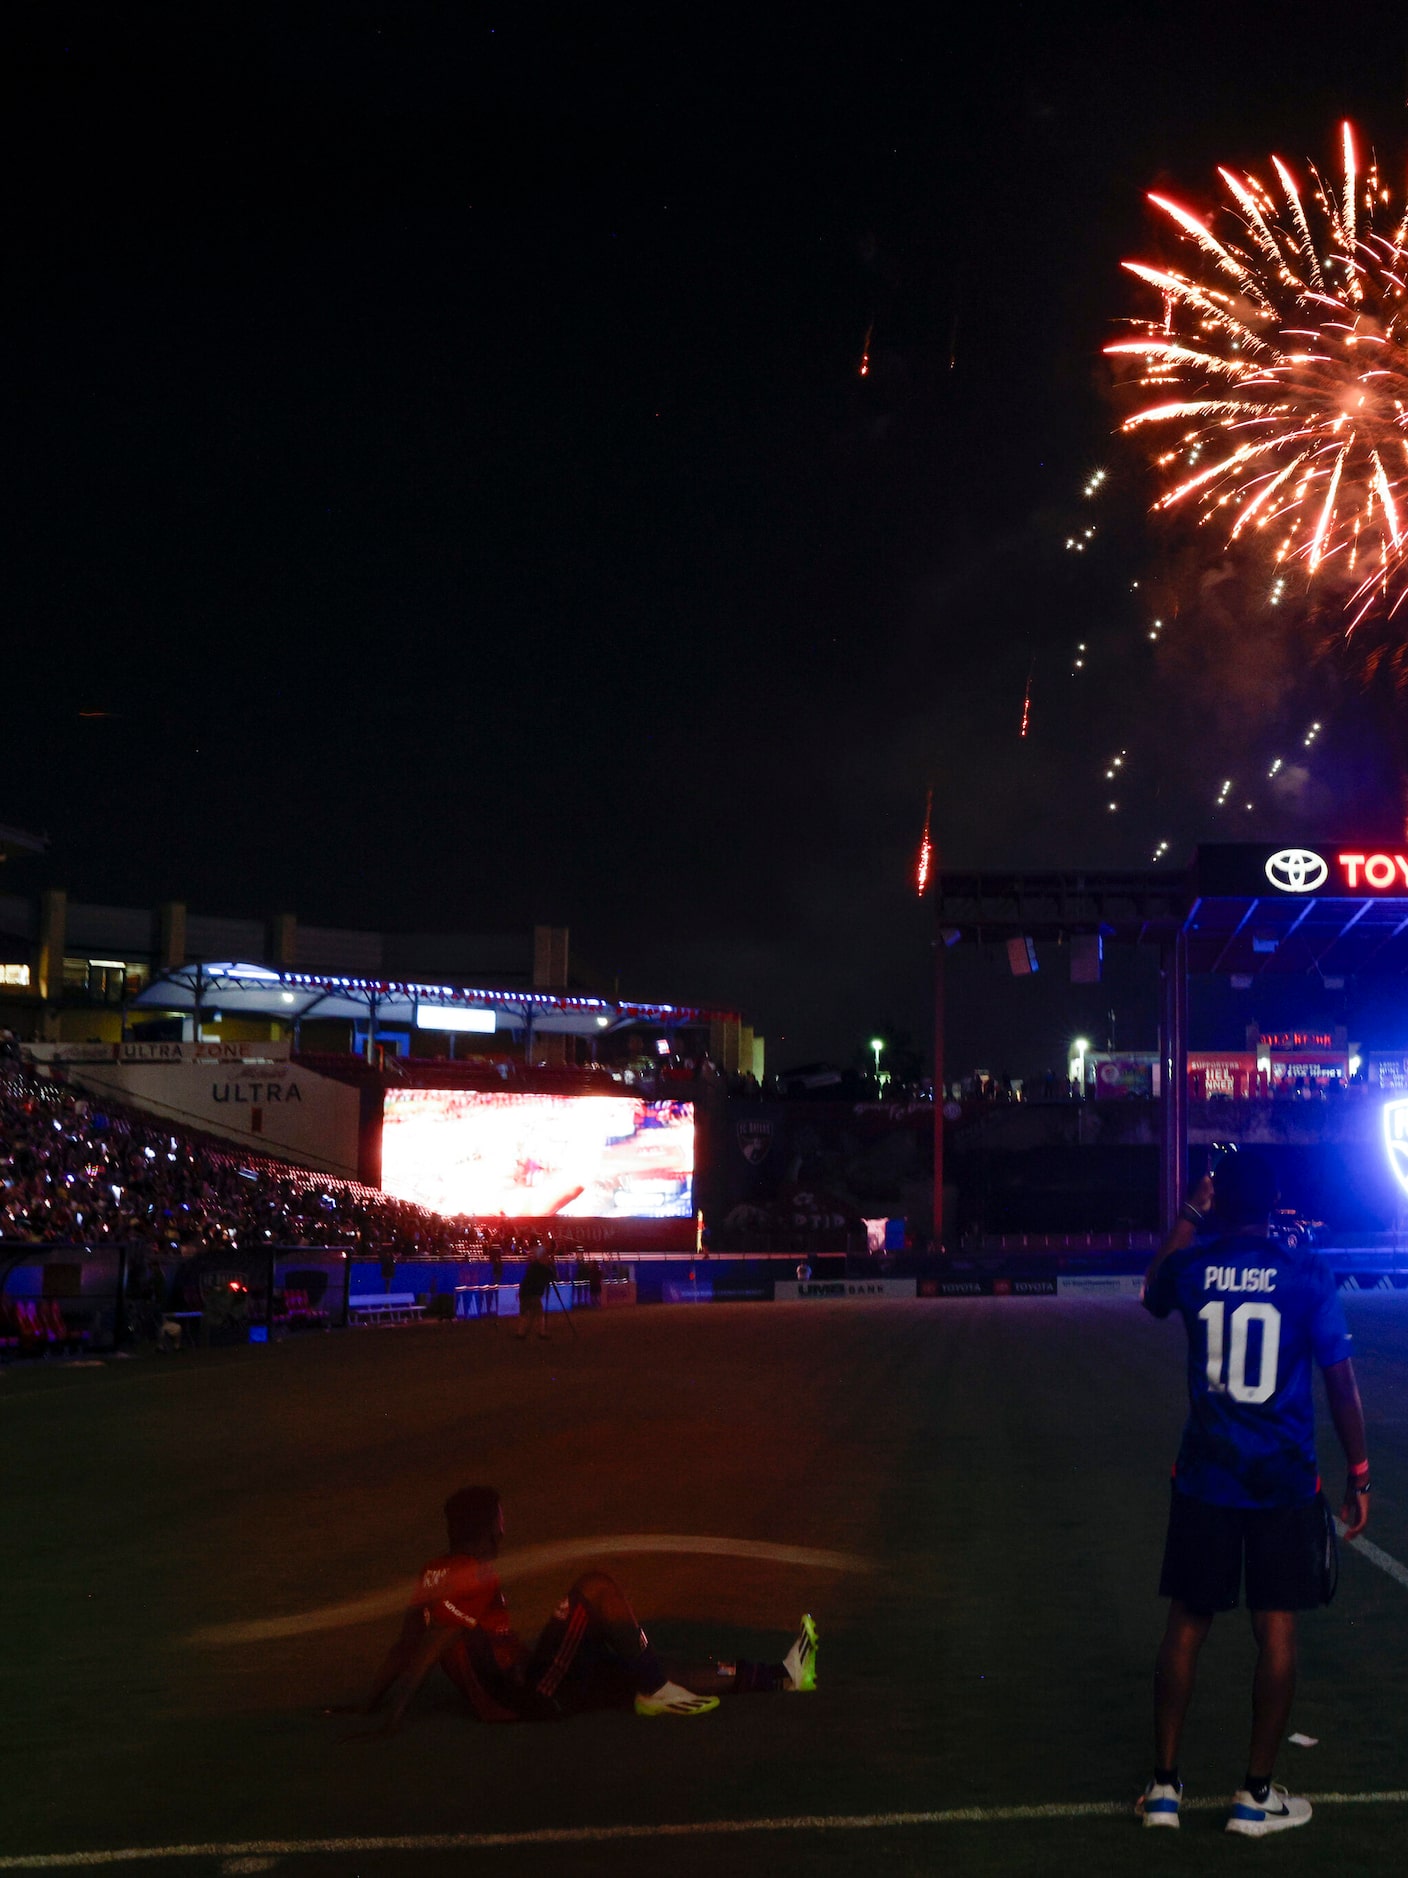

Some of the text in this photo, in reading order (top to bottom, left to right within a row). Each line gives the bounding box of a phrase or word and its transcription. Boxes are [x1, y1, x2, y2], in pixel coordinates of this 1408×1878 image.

[124, 1044, 183, 1058] ULTRA
[195, 1043, 250, 1057] ZONE
[213, 1083, 302, 1102] ULTRA
[1203, 1265, 1278, 1293] PULISIC
[1196, 1300, 1282, 1405] 10
